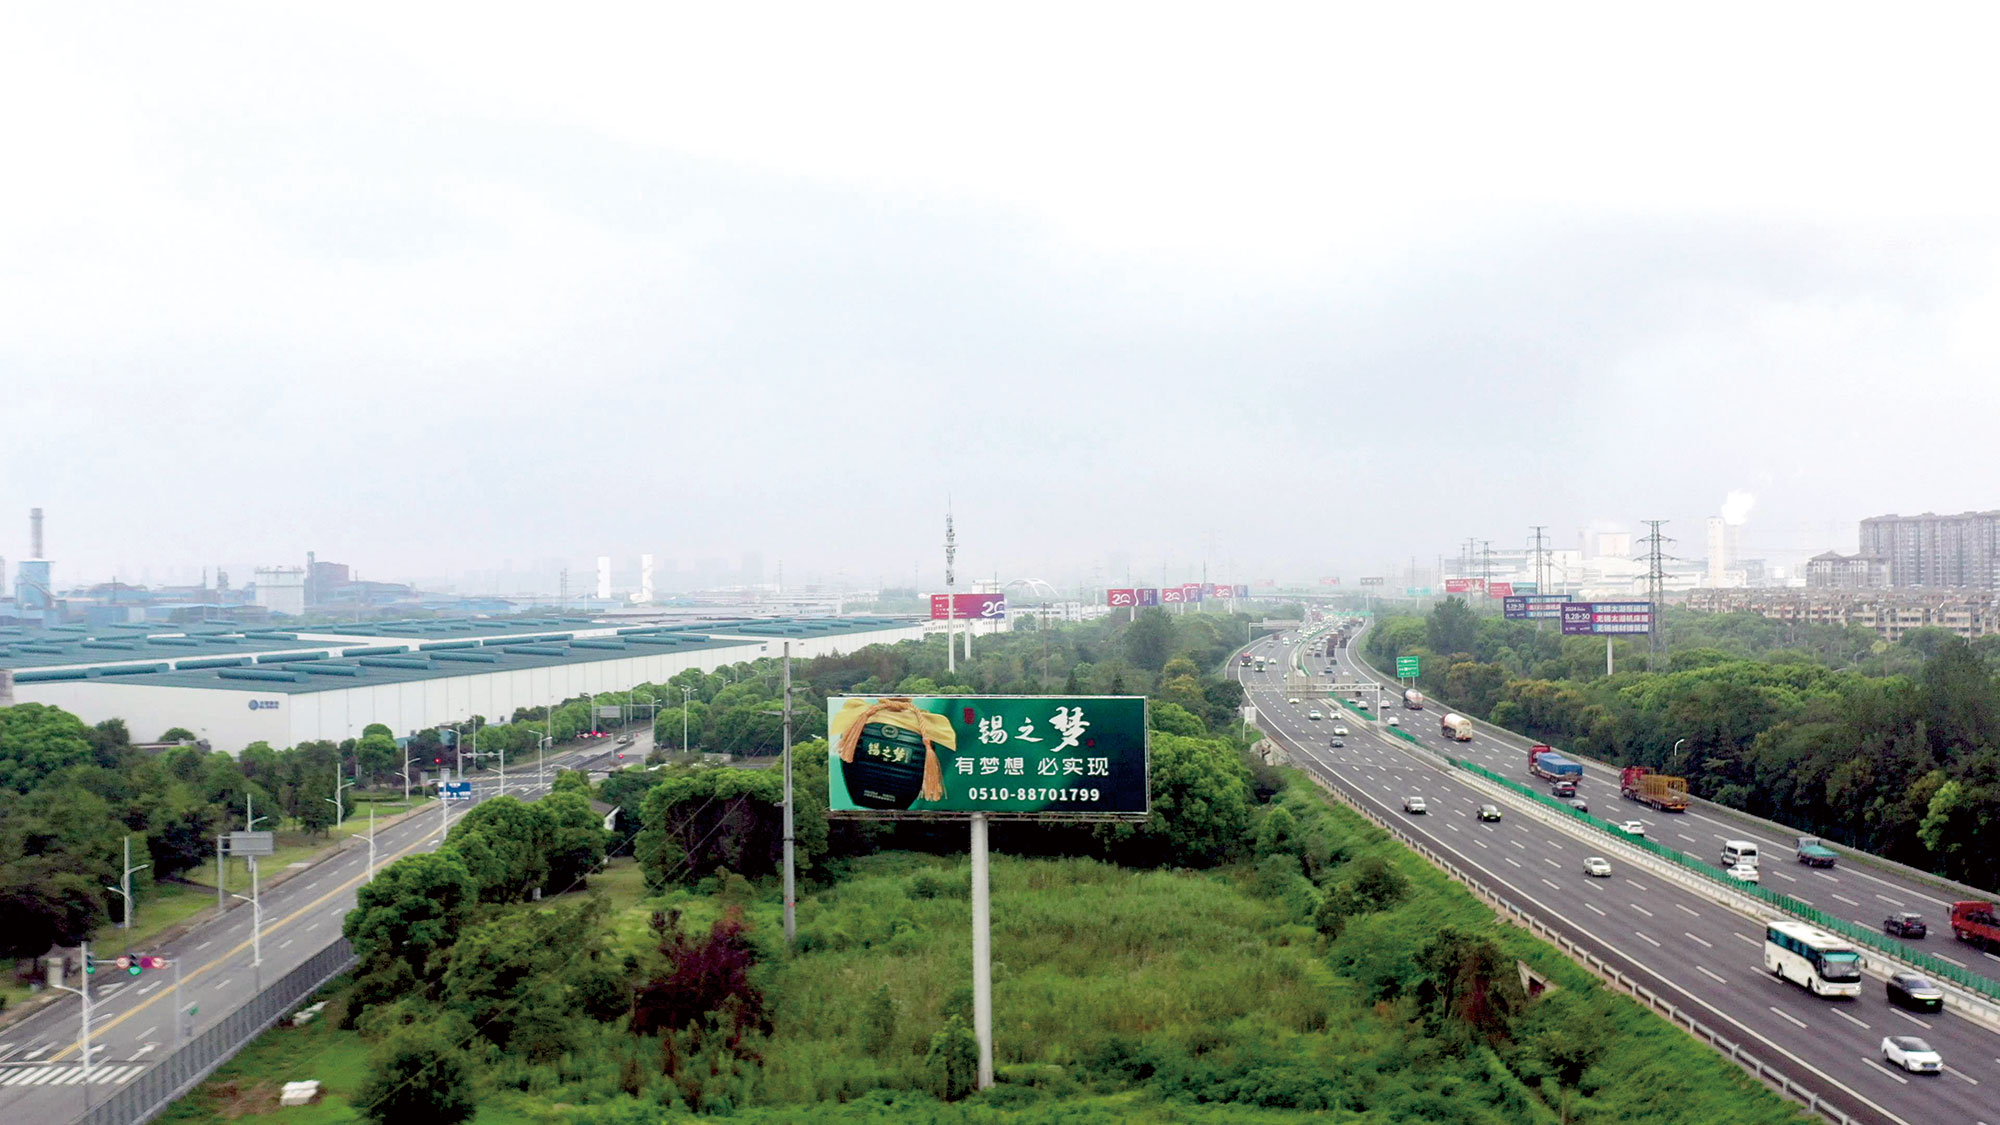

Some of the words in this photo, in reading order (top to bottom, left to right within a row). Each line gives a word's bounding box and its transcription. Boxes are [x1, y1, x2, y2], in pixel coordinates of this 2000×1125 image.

[978, 706, 1091, 752] 锡之梦
[867, 742, 906, 762] 锡之梦
[954, 757, 1025, 775] 有梦想
[1037, 757, 1110, 776] 必实现
[968, 787, 1100, 801] 0510-88701799
